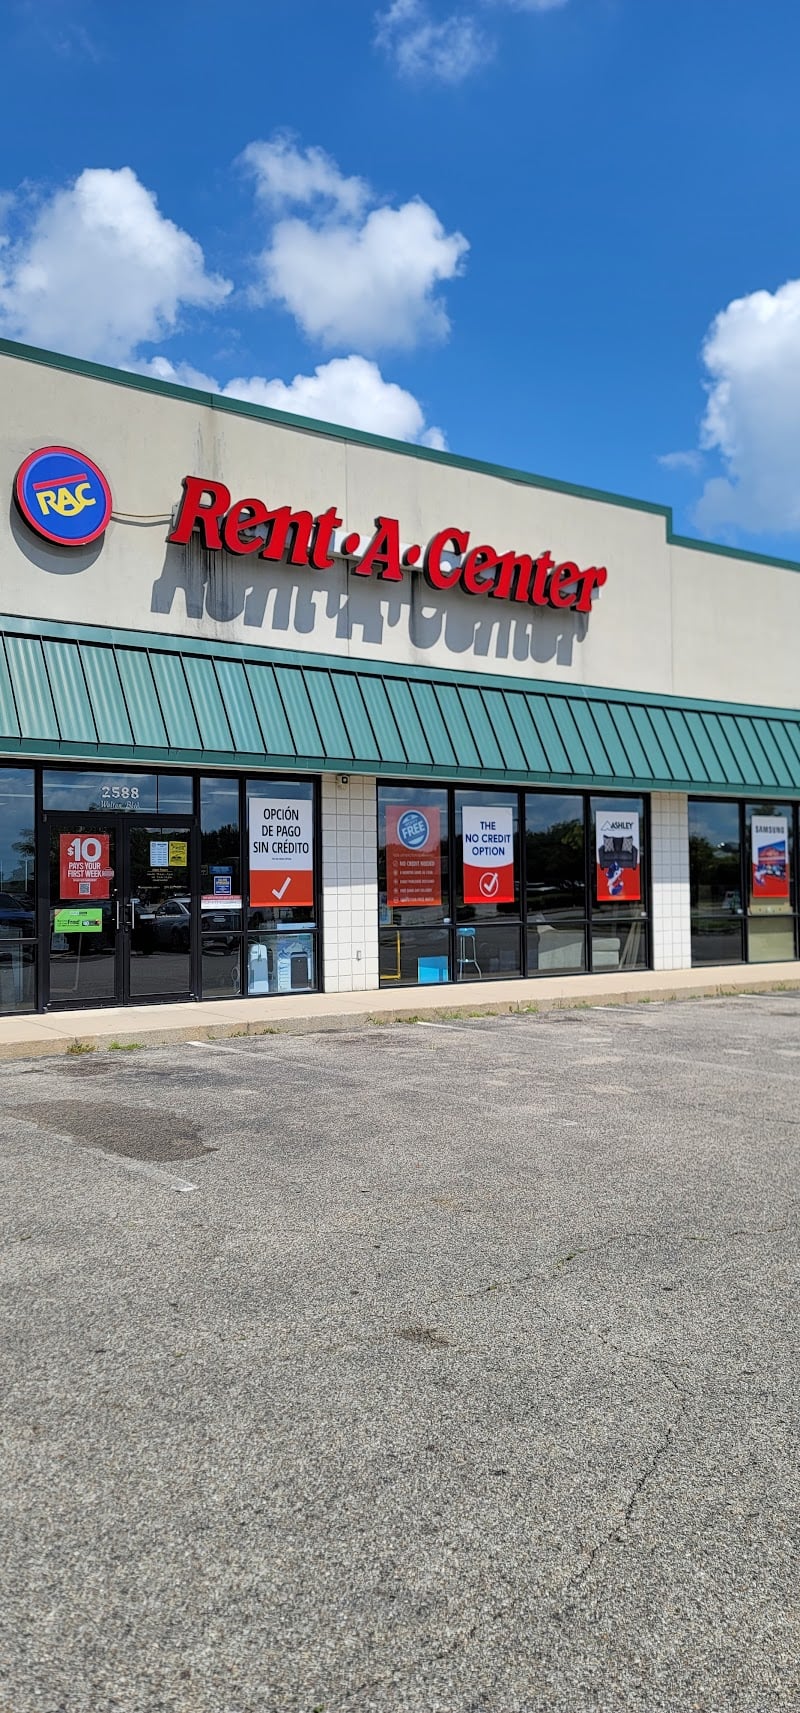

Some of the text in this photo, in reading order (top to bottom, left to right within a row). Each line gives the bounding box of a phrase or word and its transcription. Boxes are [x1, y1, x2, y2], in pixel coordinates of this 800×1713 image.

[36, 483, 96, 517] RAC
[101, 786, 139, 799] 2588
[263, 806, 299, 820] OPCIÓN
[262, 825, 301, 837] DE PAGO
[401, 821, 426, 840] FREE
[480, 821, 496, 830] THE
[611, 821, 634, 830] ASHLEY
[755, 825, 785, 834] SAMSUNG
[465, 833, 511, 843] NO CREDIT
[67, 837, 102, 863] $10
[253, 839, 309, 854] SIN CRÉDITO
[472, 846, 505, 856] OPTION
[69, 861, 101, 870] PAYS YOUR
[85, 870, 102, 878] WEEK
